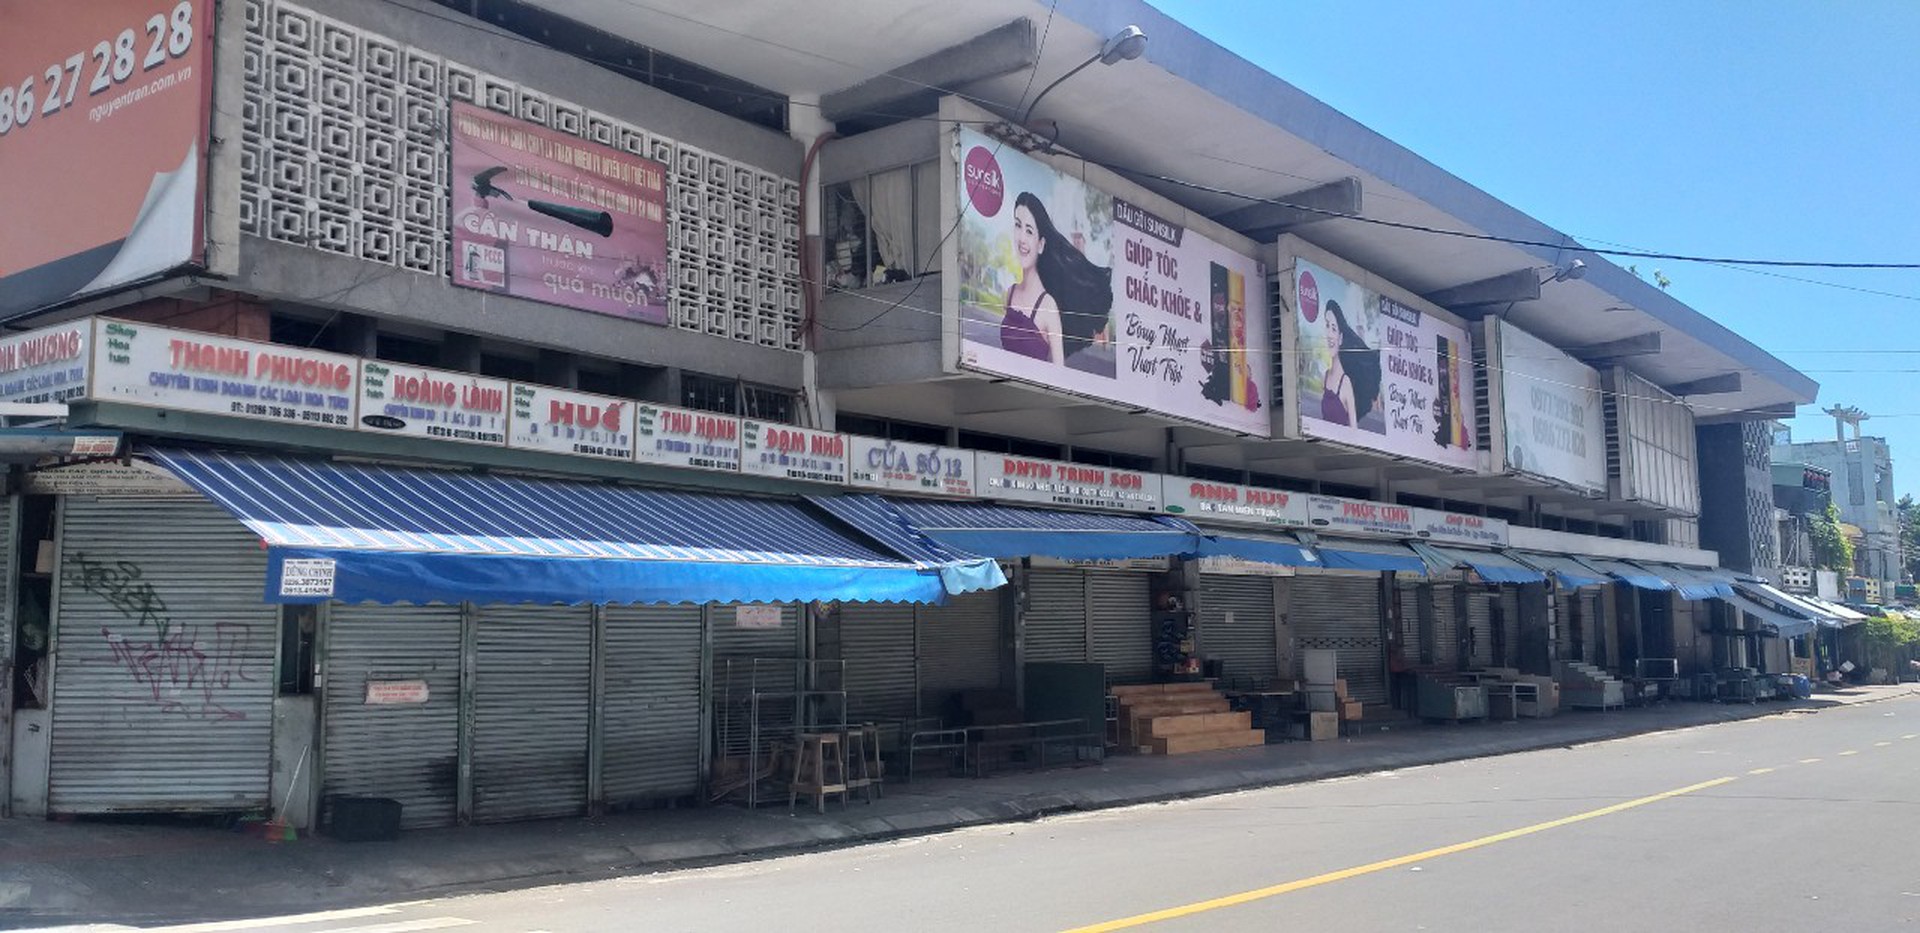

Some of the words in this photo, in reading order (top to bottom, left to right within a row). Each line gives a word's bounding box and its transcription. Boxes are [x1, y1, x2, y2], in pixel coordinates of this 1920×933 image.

[42, 52, 85, 118] 27
[89, 28, 136, 96] 28
[143, 1, 192, 72] 28
[89, 66, 192, 122] nguyentran.com.vn
[967, 162, 1002, 188] sunsilk
[1117, 202, 1134, 219] DẦU
[1134, 209, 1147, 230] GỘI
[1147, 216, 1177, 242] SUNSILK
[527, 227, 593, 260] THẬN
[1125, 238, 1153, 272] GIÚP
[1156, 250, 1178, 281] TÓC
[543, 273, 584, 296] quá
[592, 281, 648, 307] muộn
[1125, 272, 1158, 306] CHẮC
[1162, 286, 1191, 319] KHỎE
[1194, 301, 1202, 324] &
[106, 323, 137, 338] Shop
[108, 338, 130, 350] Hoa
[20, 329, 81, 369] PHƯƠNG
[169, 338, 249, 377] THANH
[255, 352, 351, 392] PHƯƠNG
[149, 371, 191, 390] CHUYÊN
[193, 377, 218, 394] KINH
[221, 381, 257, 399] DOANH
[259, 385, 278, 401] CÁC
[281, 389, 302, 406] LOẠI
[305, 393, 324, 408] HOA
[393, 371, 457, 408] HOÀNG
[462, 379, 502, 413] LÀNH
[660, 411, 692, 434] THU
[695, 415, 736, 444] HẠNH
[765, 426, 805, 455] ĐẠM
[868, 442, 910, 473] CỬA
[916, 448, 941, 476] SỐ
[1002, 458, 1054, 480] DNTN
[1109, 472, 1144, 490] SƠN
[1189, 481, 1239, 503] ANH
[1245, 487, 1290, 509] HUY
[1342, 501, 1377, 521] PHÚC
[1379, 505, 1410, 523] LINH
